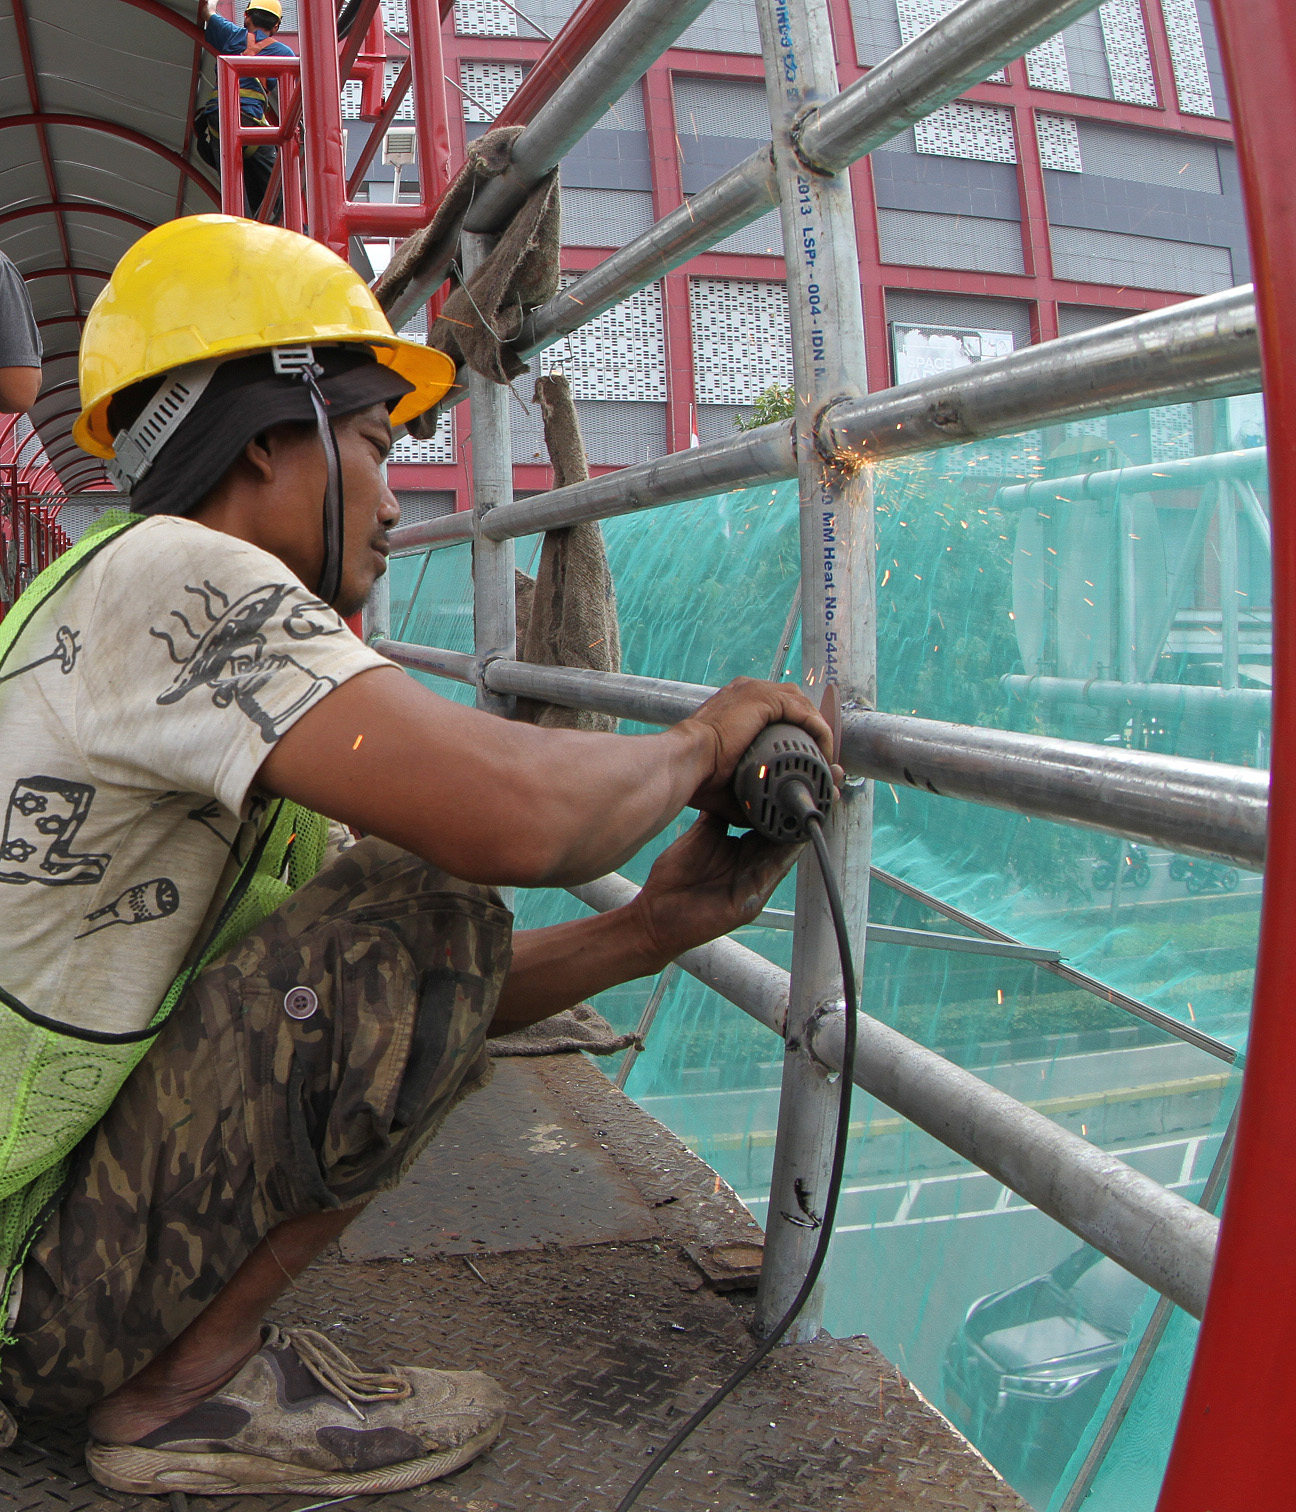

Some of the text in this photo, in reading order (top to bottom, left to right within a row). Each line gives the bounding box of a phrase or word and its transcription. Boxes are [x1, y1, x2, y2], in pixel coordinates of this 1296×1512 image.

[797, 174, 812, 216] 2013
[907, 355, 953, 371] SPACE
[822, 511, 836, 543] MM
[824, 547, 836, 590] Heat
[825, 597, 837, 627] No.
